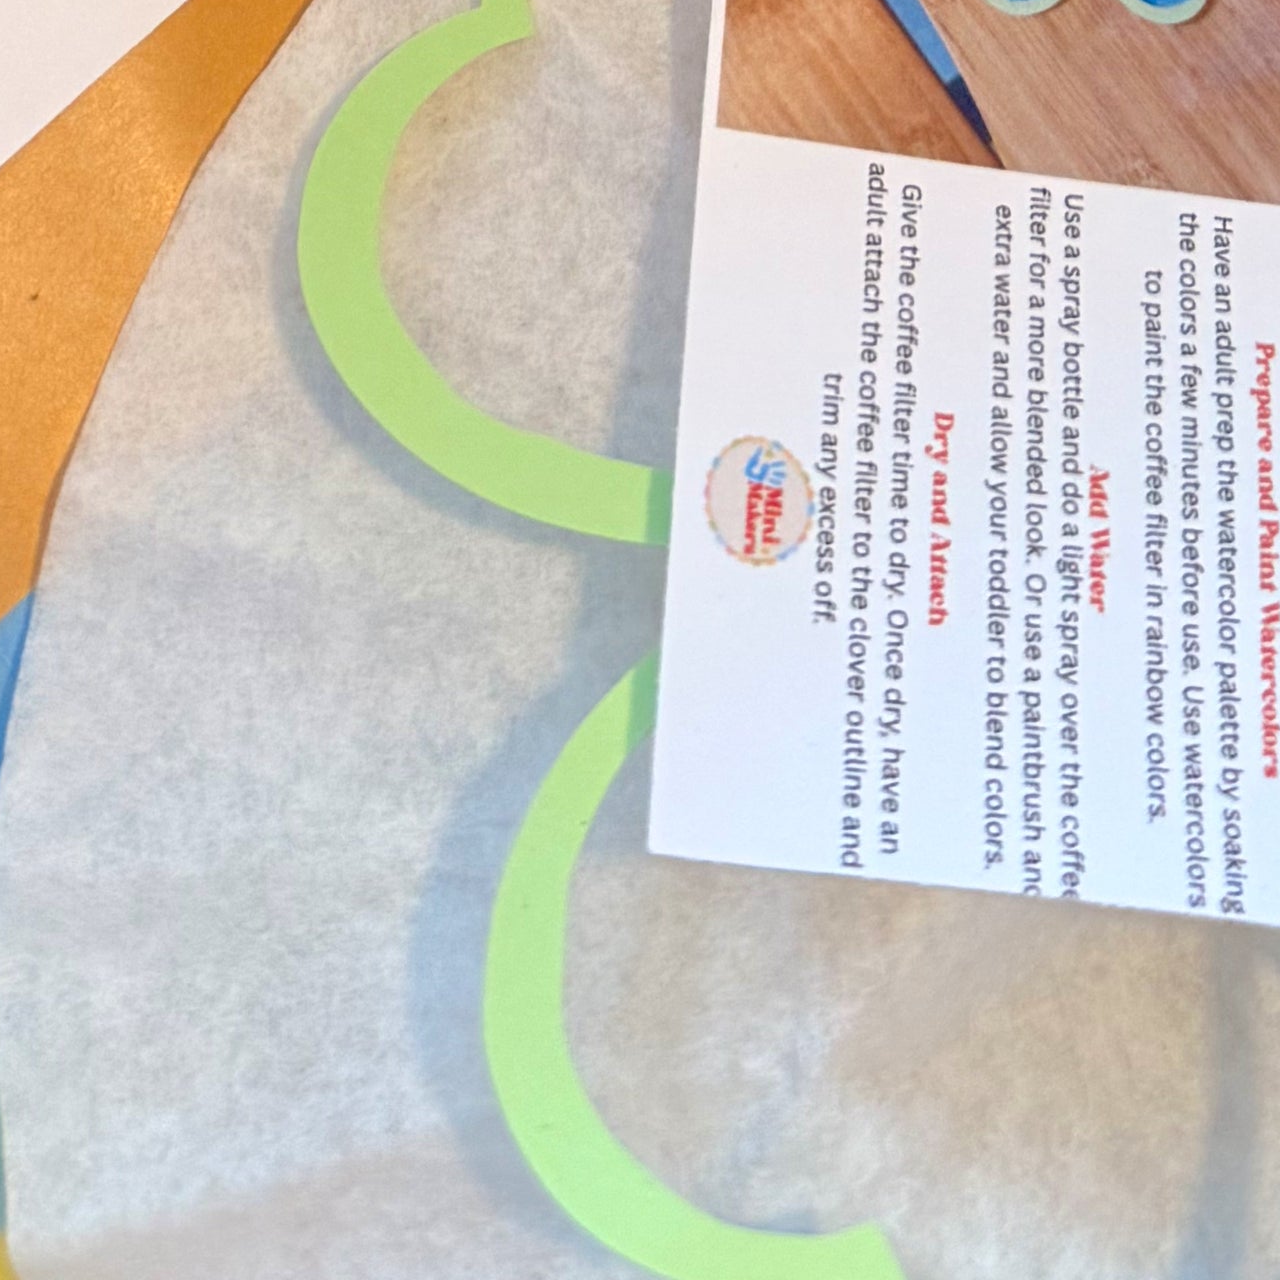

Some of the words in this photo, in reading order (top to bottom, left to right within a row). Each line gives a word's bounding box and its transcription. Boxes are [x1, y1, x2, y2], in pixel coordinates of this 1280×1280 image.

[1212, 215, 1234, 279] Have
[1144, 269, 1163, 295] to
[1214, 283, 1232, 314] an
[1139, 301, 1166, 368] paint
[1214, 319, 1237, 386] adult
[821, 372, 844, 426] trim
[1144, 373, 1166, 416] the
[1210, 391, 1235, 452] prep
[1248, 342, 1276, 453] Prepare
[814, 432, 838, 480] any
[923, 411, 955, 464] Dry
[1144, 422, 1168, 506] coffee
[930, 470, 951, 526] and
[1088, 465, 1110, 519] Add
[1216, 459, 1239, 503] the
[1257, 457, 1279, 512] and
[742, 480, 764, 556] Makers
[761, 486, 783, 545] Mini
[815, 485, 837, 574] excess
[1144, 513, 1169, 578] filter
[928, 532, 952, 626] Attach
[1088, 528, 1110, 613] Water
[1217, 508, 1241, 655] watercolor
[1258, 519, 1280, 592] Paint
[1145, 583, 1168, 608] in
[1145, 614, 1169, 725] rainbow
[1259, 602, 1280, 778] Watercolors
[1213, 660, 1242, 760] palette
[1145, 732, 1170, 823] colors.
[1215, 767, 1244, 801] by
[1219, 807, 1247, 914] soaking
